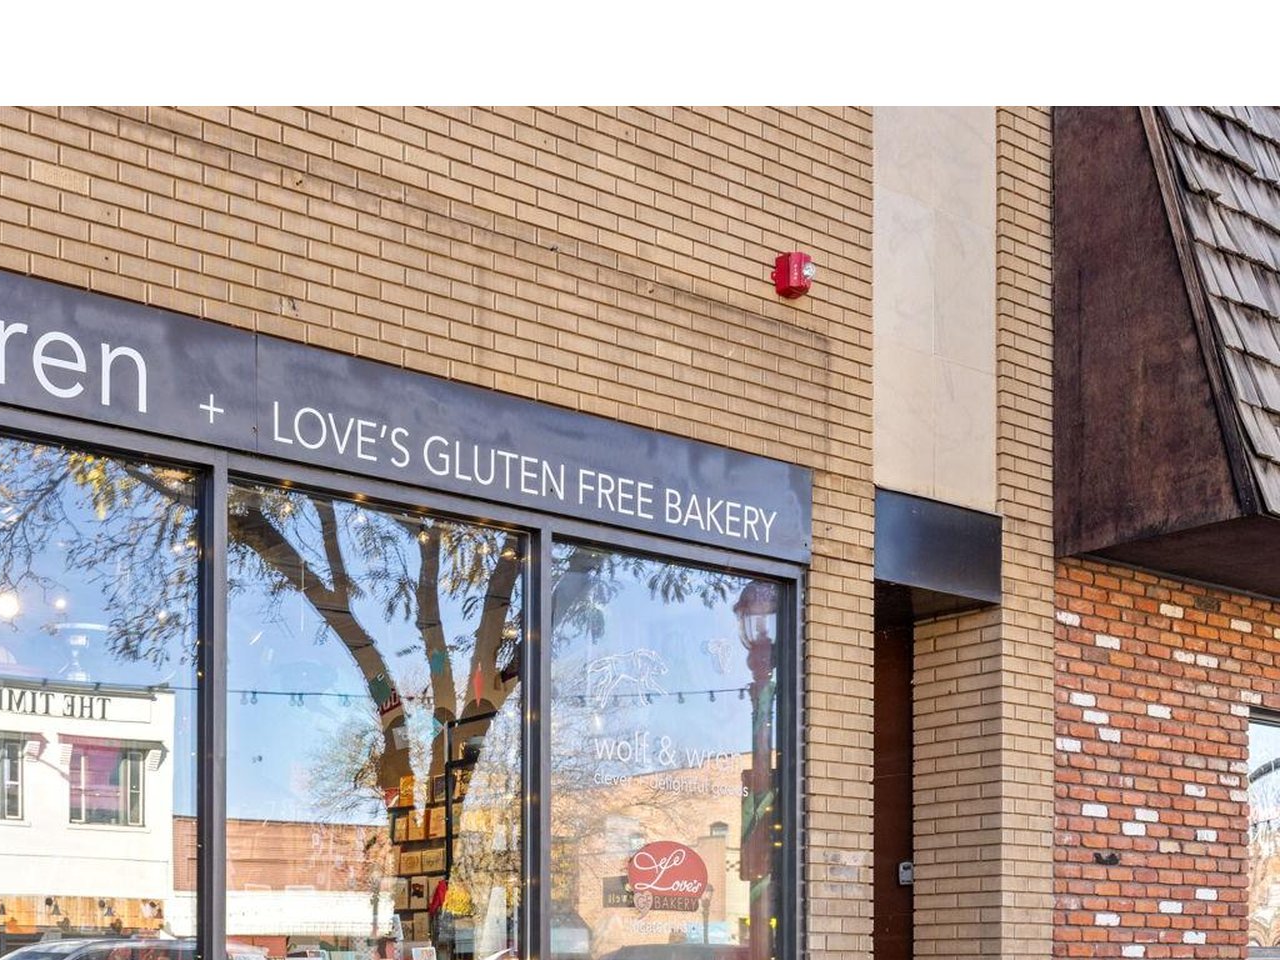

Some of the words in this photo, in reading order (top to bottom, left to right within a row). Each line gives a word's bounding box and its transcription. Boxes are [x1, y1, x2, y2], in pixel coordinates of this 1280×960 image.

[199, 393, 225, 424] +
[273, 401, 410, 468] LOVE'S
[423, 435, 566, 501] GLUTEN
[578, 470, 654, 519] FREE
[665, 488, 778, 544] BAKERY
[593, 731, 651, 764] wolf
[657, 735, 677, 767] &
[654, 896, 697, 911] BAKERY
